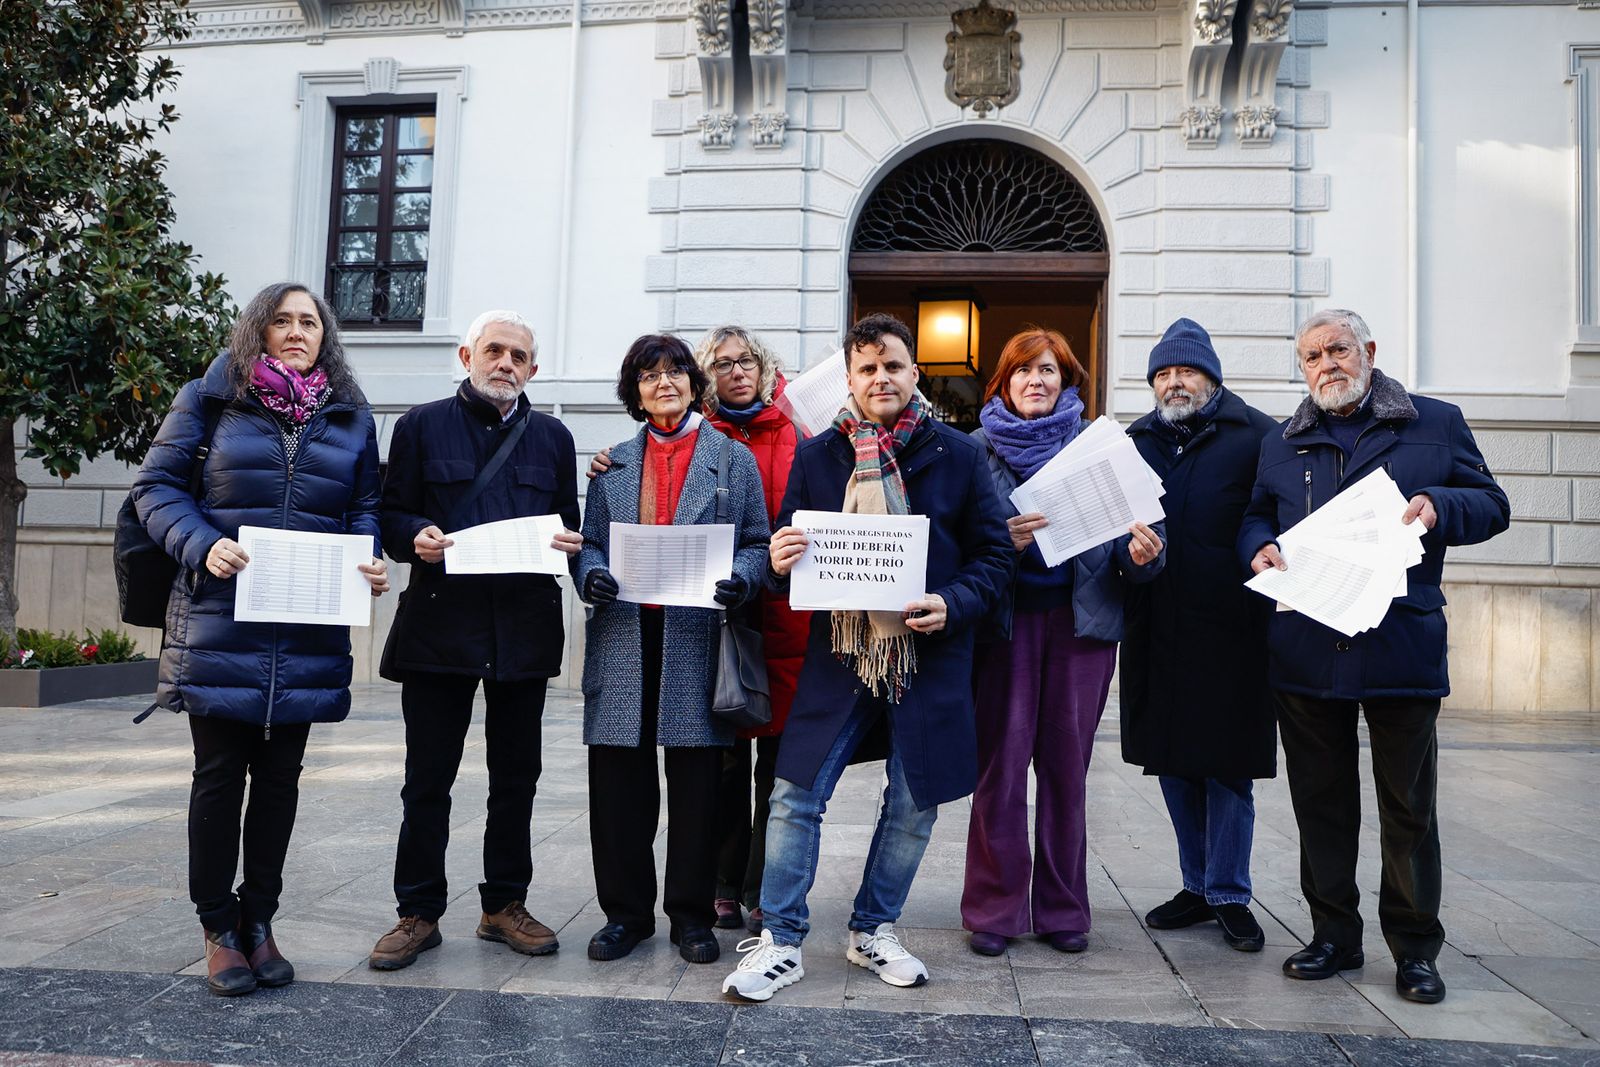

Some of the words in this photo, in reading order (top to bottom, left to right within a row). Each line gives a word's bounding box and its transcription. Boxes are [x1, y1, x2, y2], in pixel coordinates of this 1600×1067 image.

[814, 540, 849, 550] NADIE
[853, 541, 904, 552] DEBERÍA
[813, 555, 852, 565] MORIR
[856, 558, 872, 566] DE
[876, 556, 904, 568] FRÍO
[819, 571, 834, 580] EN
[838, 572, 895, 583] GRANADA
